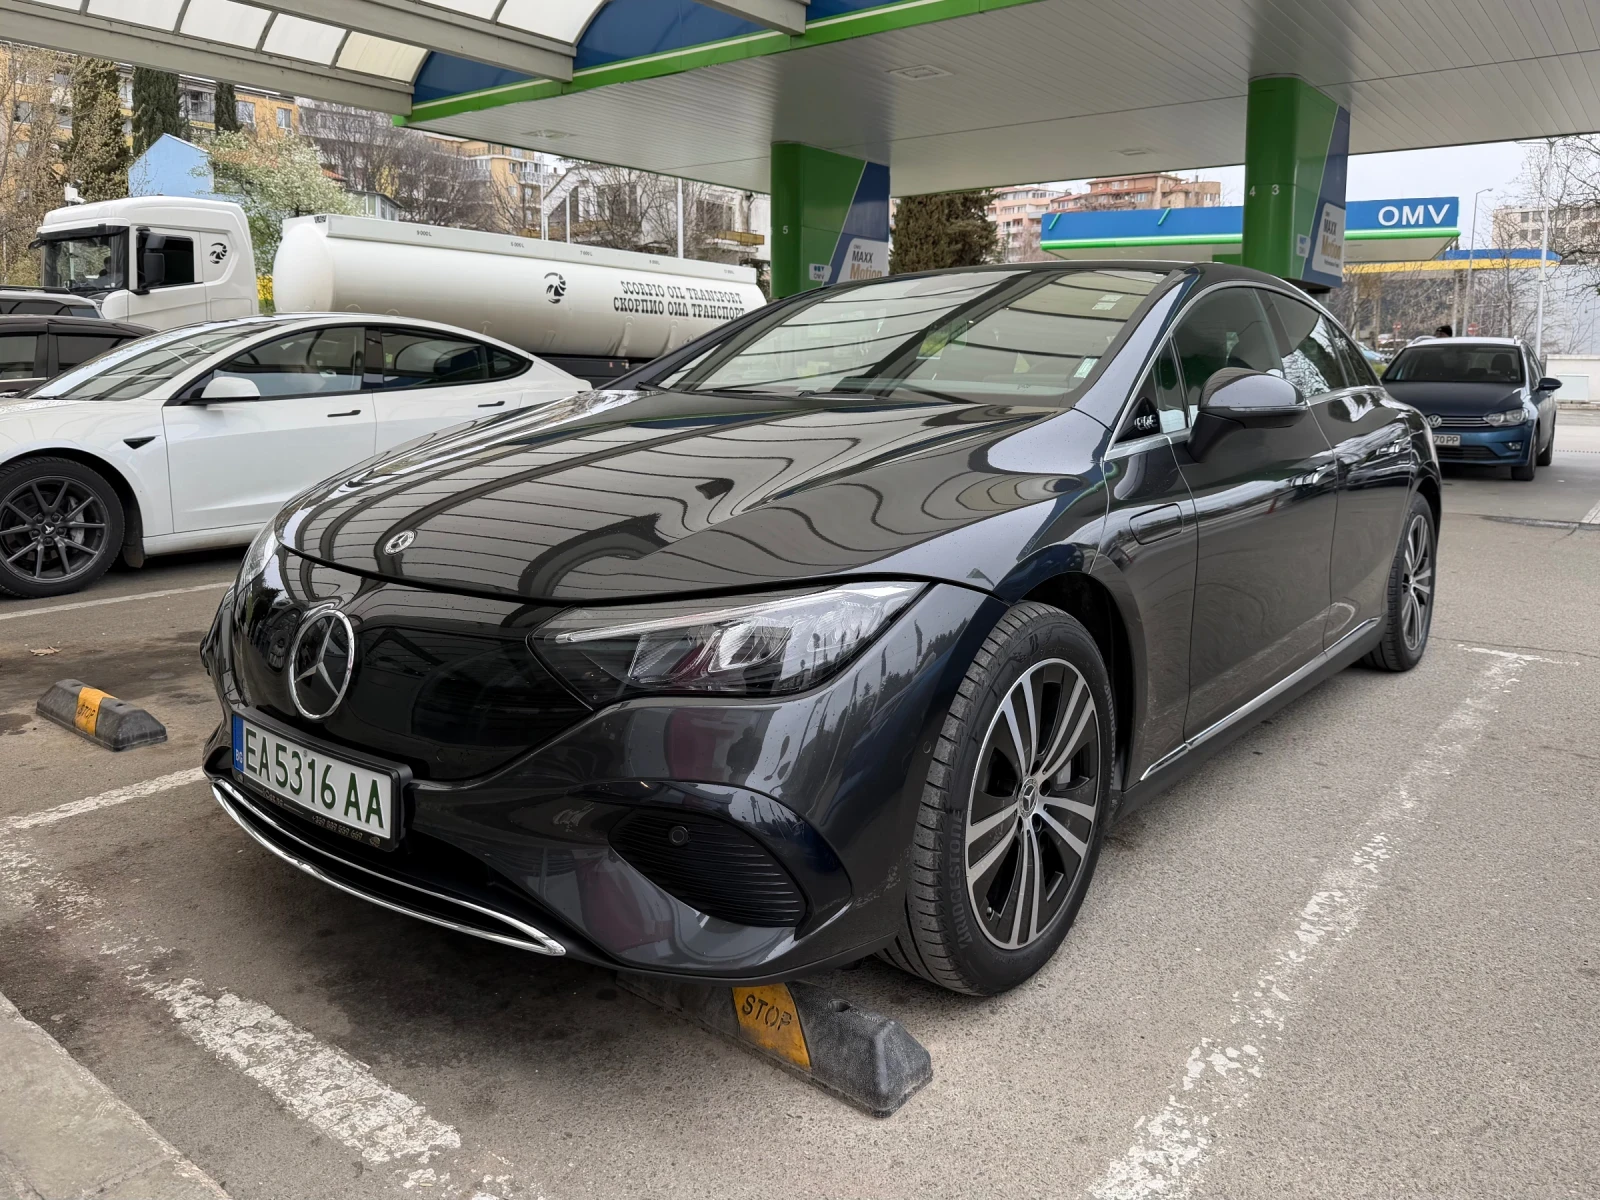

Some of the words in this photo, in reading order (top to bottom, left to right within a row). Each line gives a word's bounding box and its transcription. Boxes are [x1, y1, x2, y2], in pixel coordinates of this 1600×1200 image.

[1249, 185, 1256, 197] 4
[1271, 184, 1280, 196] 3
[1377, 203, 1451, 227] OMV
[782, 225, 789, 235] 5
[852, 250, 874, 264] MAXX
[850, 263, 883, 280] Motion
[620, 280, 665, 298] SCORPIO
[667, 285, 686, 300] OIL
[686, 287, 743, 305] TRANSPORT
[613, 297, 665, 315] СКОРПИО
[667, 301, 689, 317] ОИЛ
[691, 303, 745, 320] ТРАНСПОРТ
[77, 703, 96, 719] STOP
[235, 748, 243, 764] BG
[949, 809, 973, 949] BRIDGESTONE
[741, 993, 792, 1031] STOP
